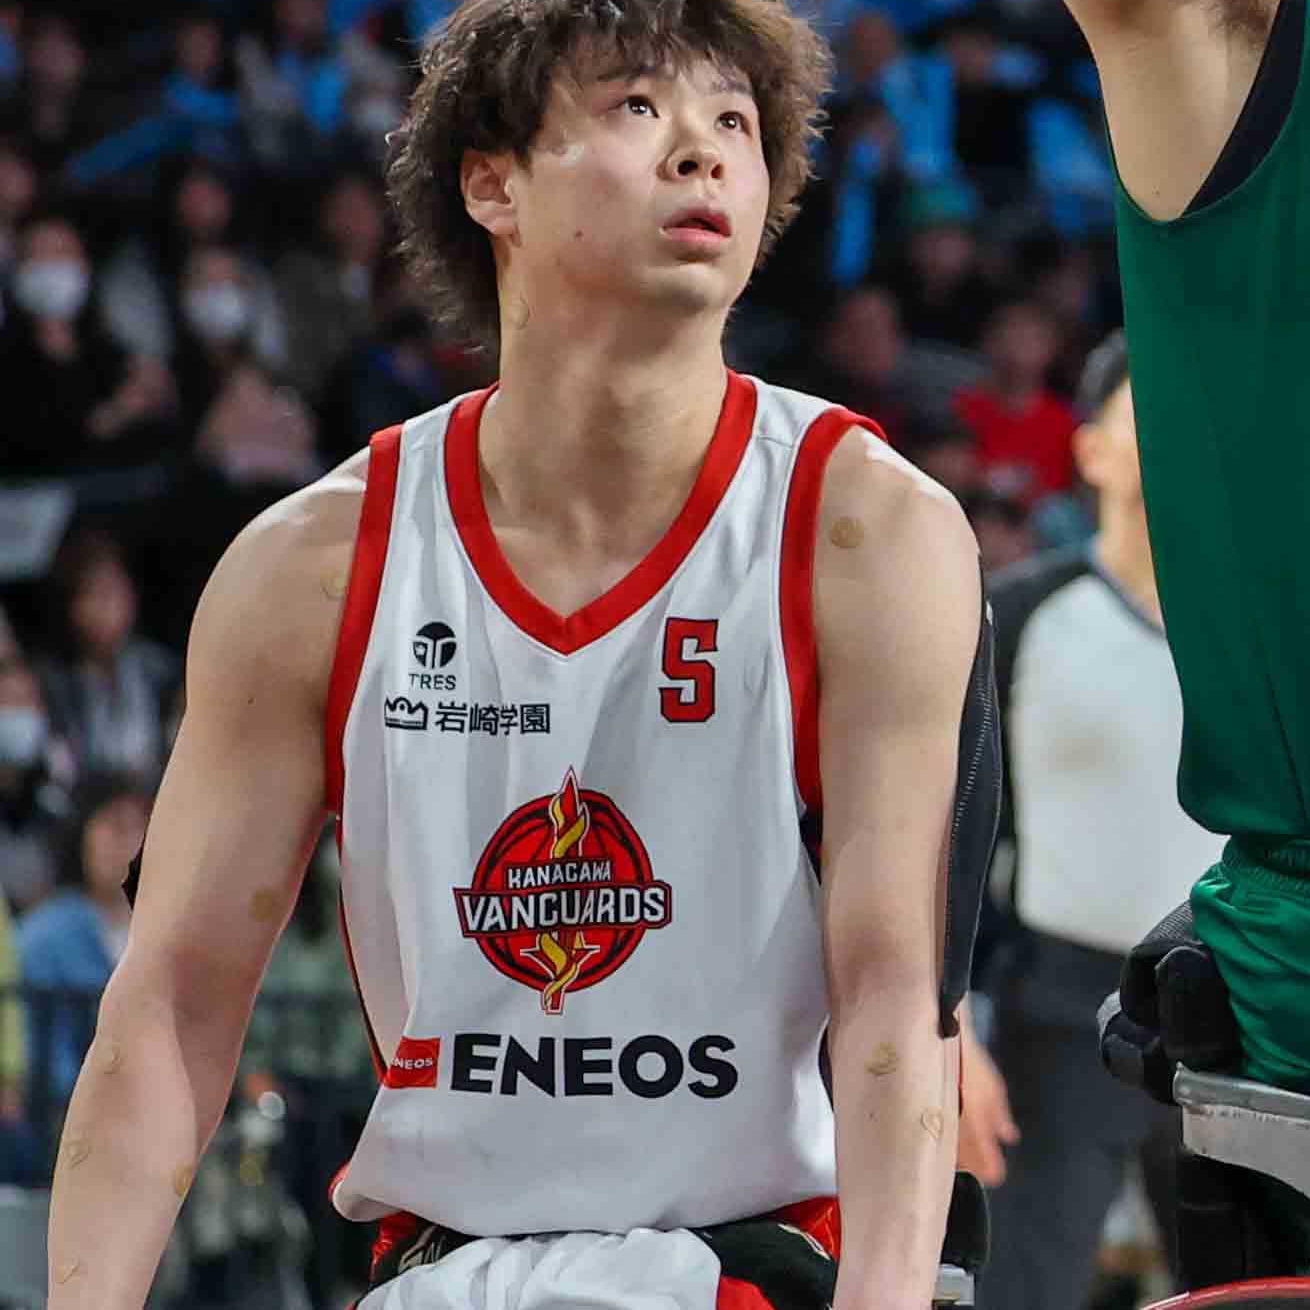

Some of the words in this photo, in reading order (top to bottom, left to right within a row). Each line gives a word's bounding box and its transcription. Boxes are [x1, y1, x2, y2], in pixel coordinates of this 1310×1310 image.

[409, 673, 457, 691] TRES
[658, 616, 719, 723] 5
[435, 701, 551, 737] 岩崎学園
[462, 887, 665, 932] VANGUARDS
[450, 1033, 739, 1100] ENEOS
